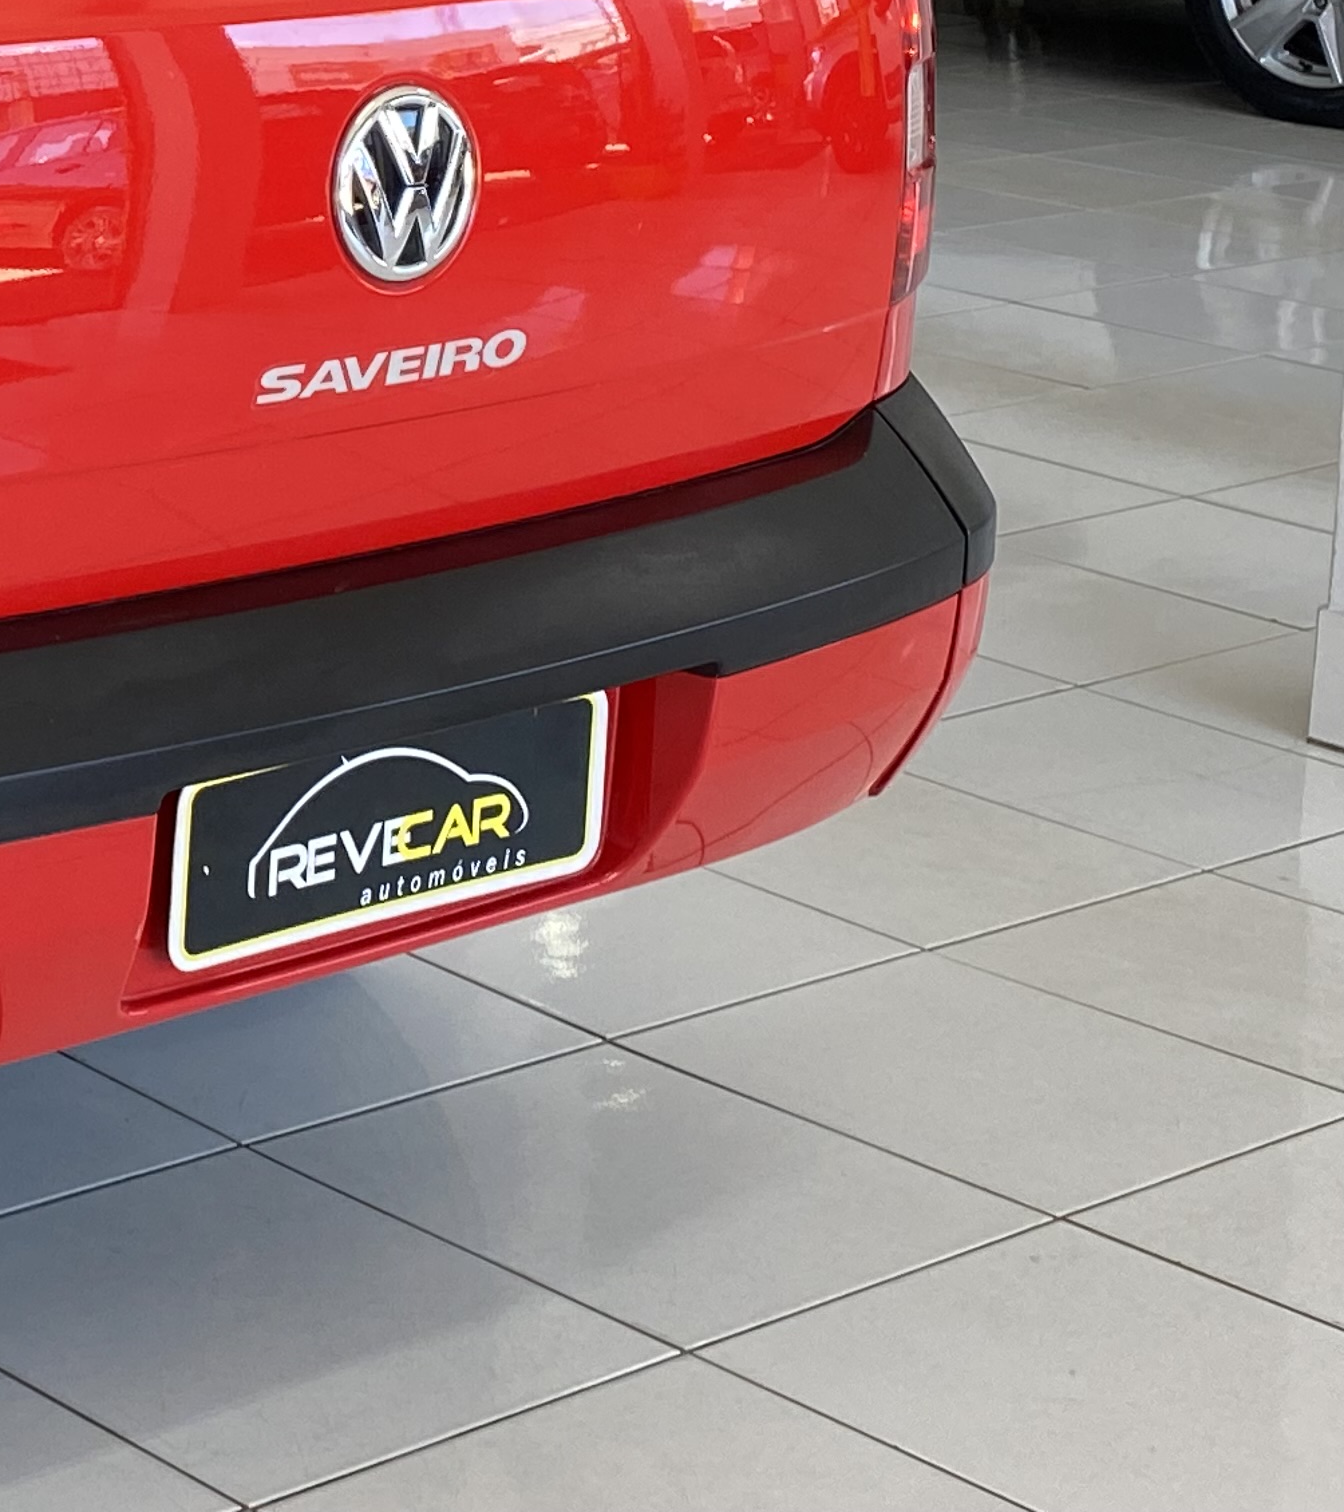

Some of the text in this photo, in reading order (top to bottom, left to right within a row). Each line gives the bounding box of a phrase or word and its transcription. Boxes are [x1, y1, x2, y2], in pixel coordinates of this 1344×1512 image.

[255, 328, 528, 405] SAVEIRO
[267, 792, 513, 898] REVECAR
[359, 847, 528, 907] automóveis
